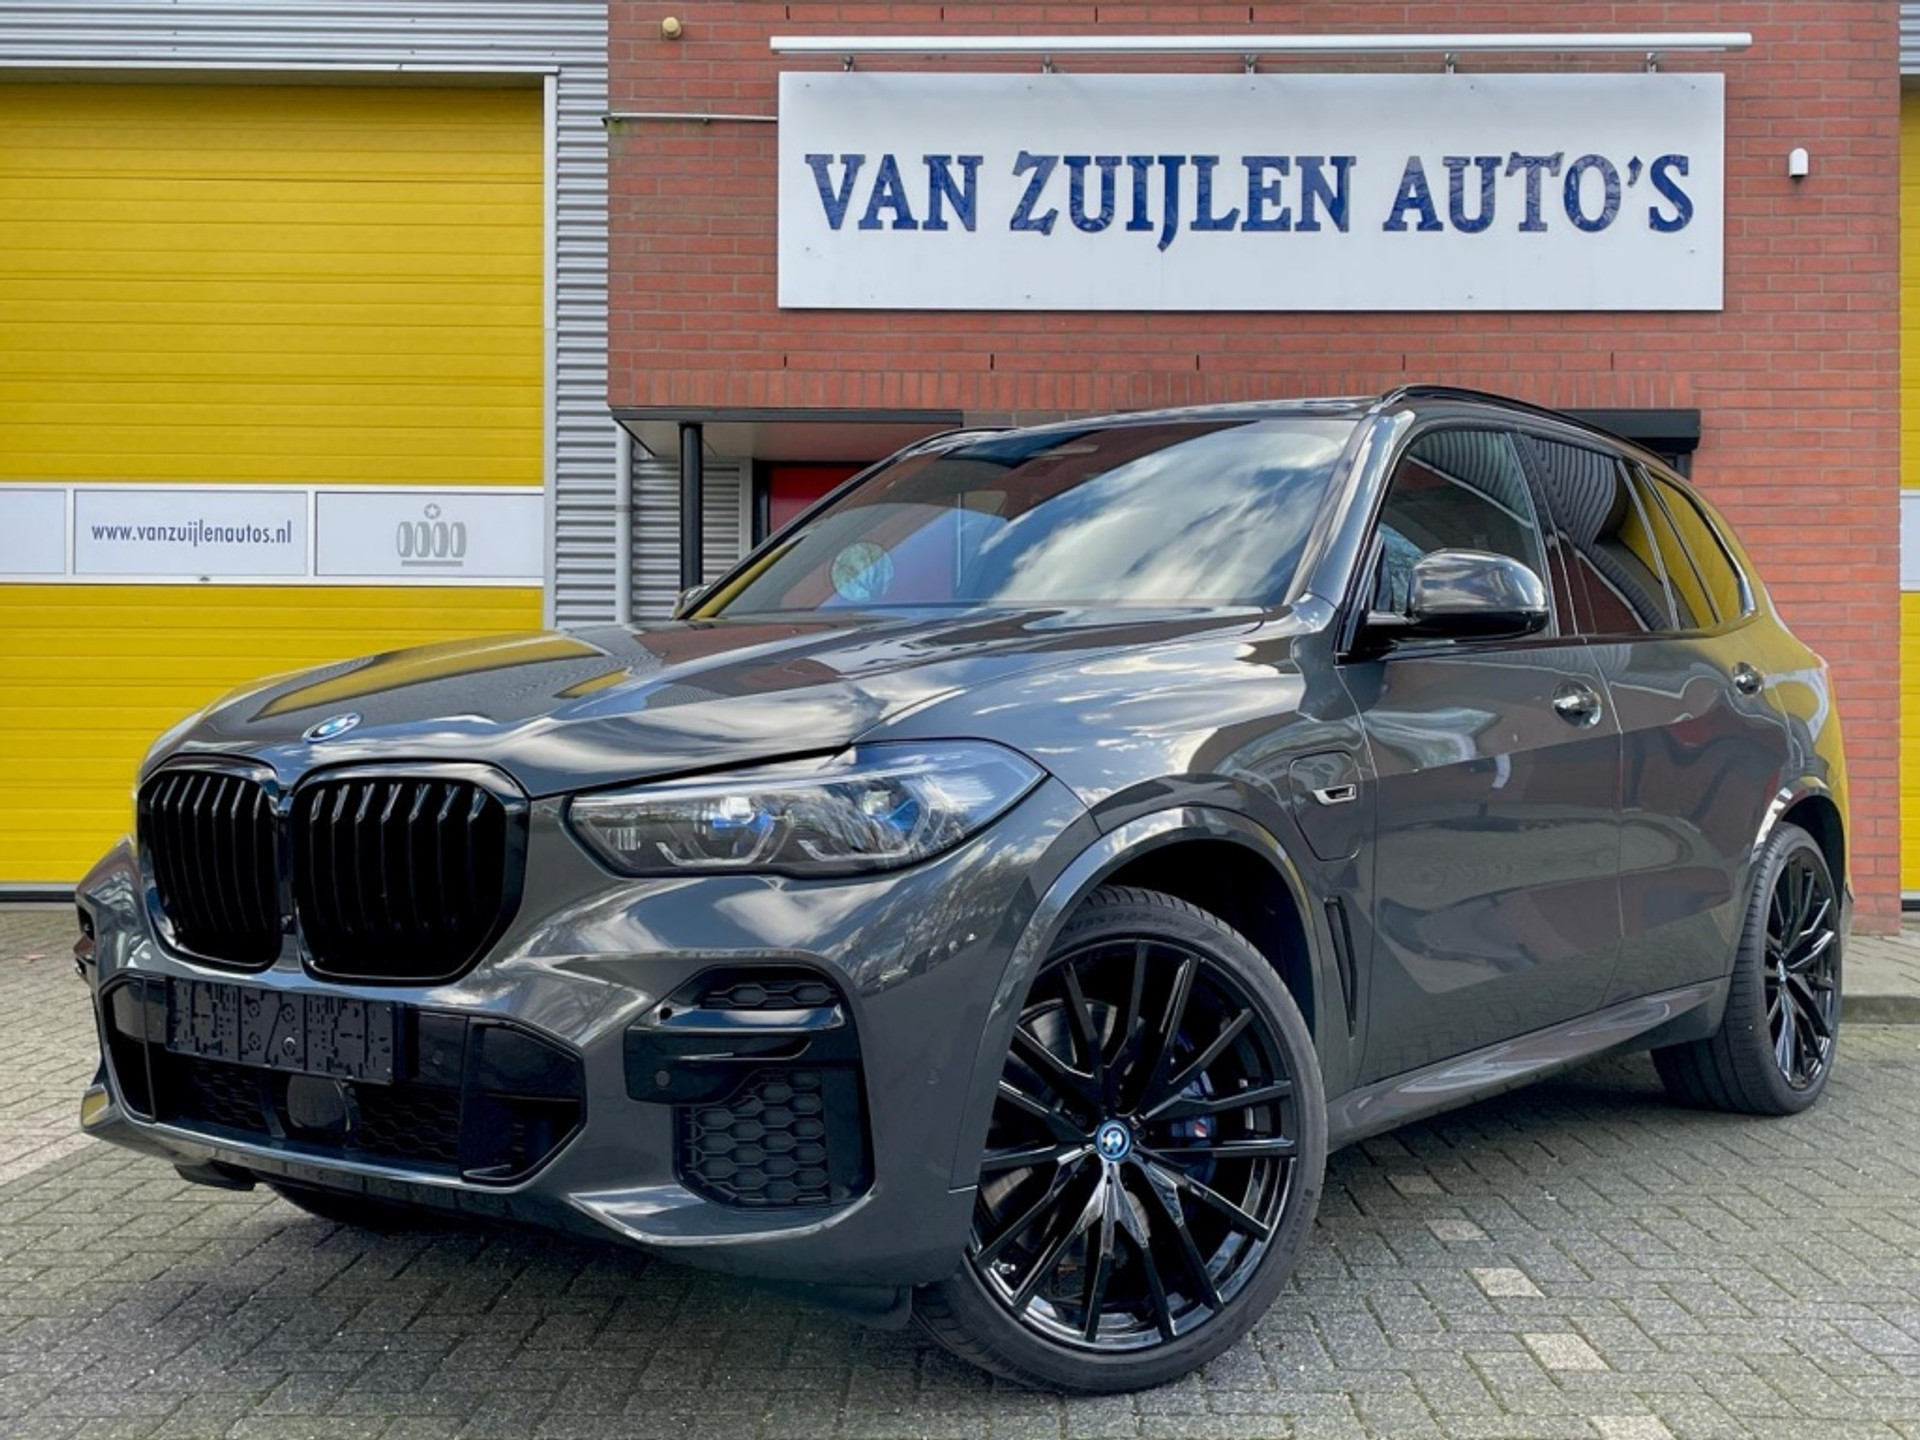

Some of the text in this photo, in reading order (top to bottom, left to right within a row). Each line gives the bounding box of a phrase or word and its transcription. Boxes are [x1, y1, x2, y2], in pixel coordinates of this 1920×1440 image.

[804, 150, 1694, 253] VAN ZUIJLEN AUTO'S
[91, 519, 292, 547] www.vanzuijlenautos.nl
